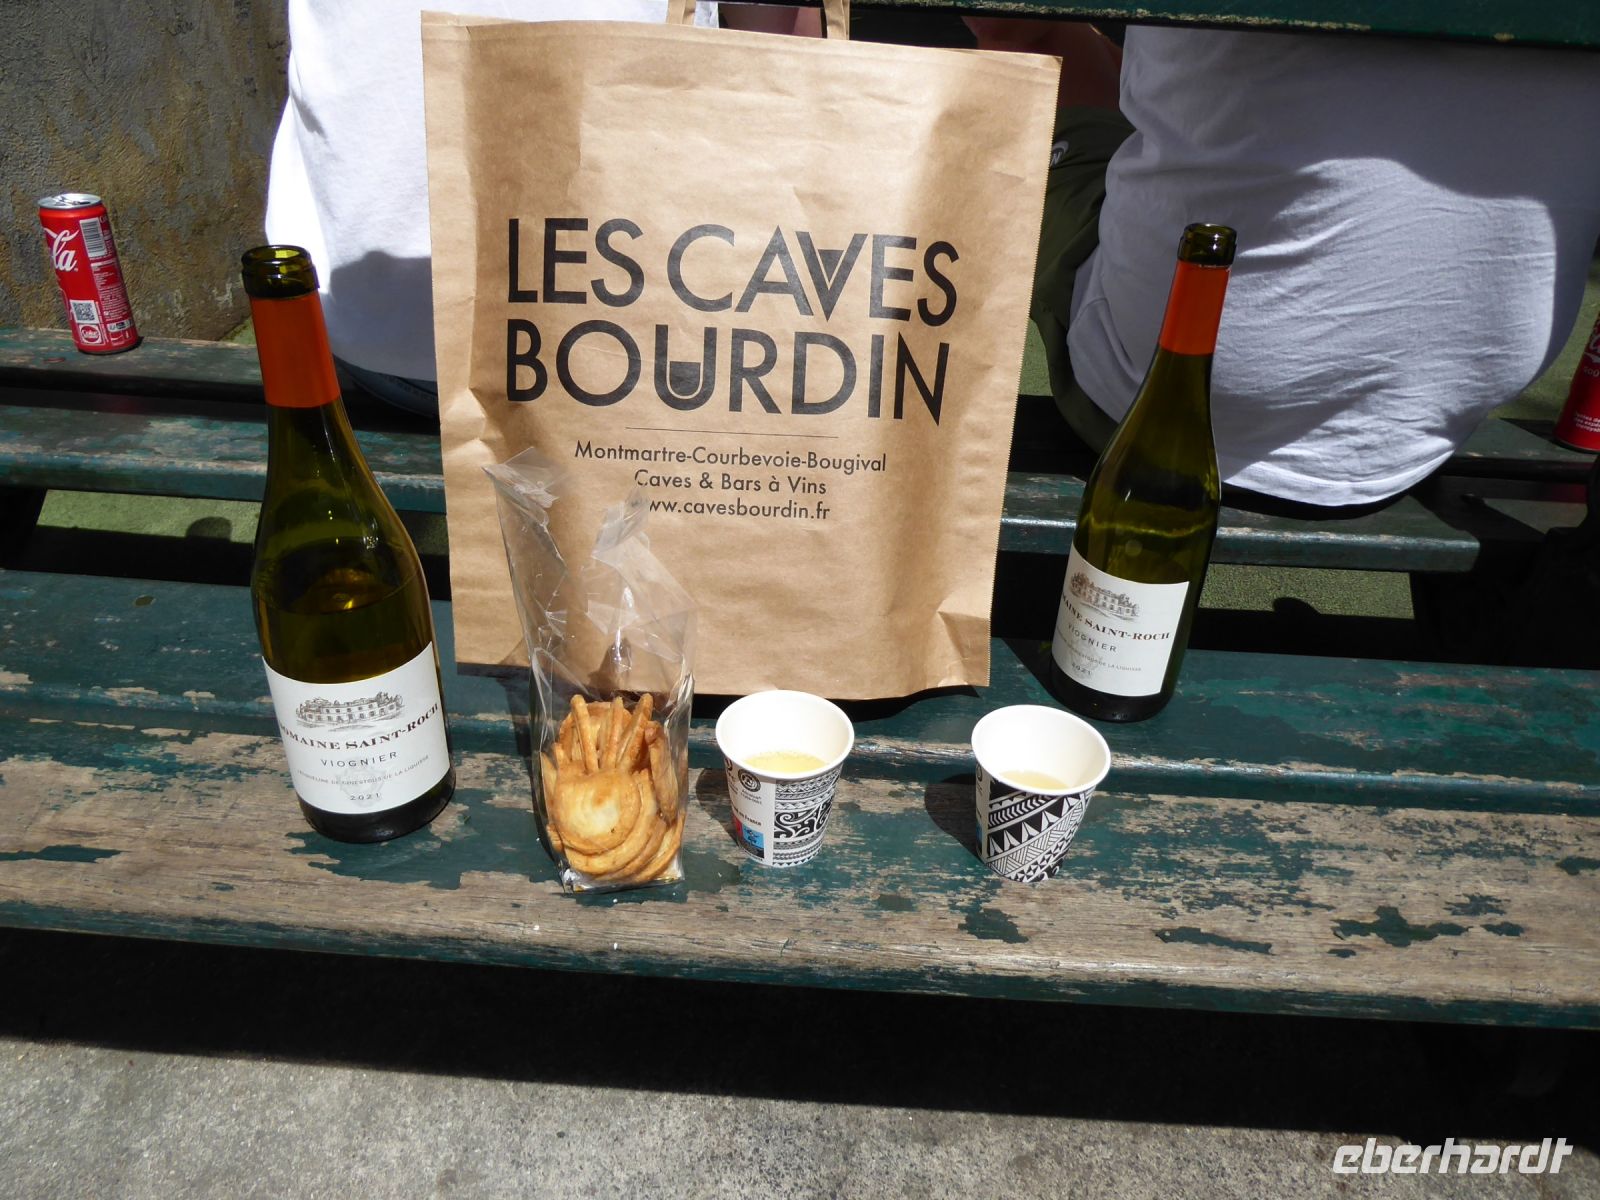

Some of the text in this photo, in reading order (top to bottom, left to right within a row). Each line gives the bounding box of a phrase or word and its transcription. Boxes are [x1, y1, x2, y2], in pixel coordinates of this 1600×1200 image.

[508, 217, 960, 327] LES CAVES
[506, 318, 950, 427] BOURDIN
[574, 439, 887, 475] Montmartre-Courbevoie-Bougival
[634, 468, 827, 495] Caves & Bars à Vins
[649, 497, 831, 520] ww.cavesbourdin.fr
[1068, 623, 1117, 653] VIOGNIER
[1085, 618, 1170, 641] SAINT-ROCH
[345, 703, 439, 750] SAINT-ROCH
[320, 751, 398, 768] VIOGNIER
[350, 792, 383, 801] 2021
